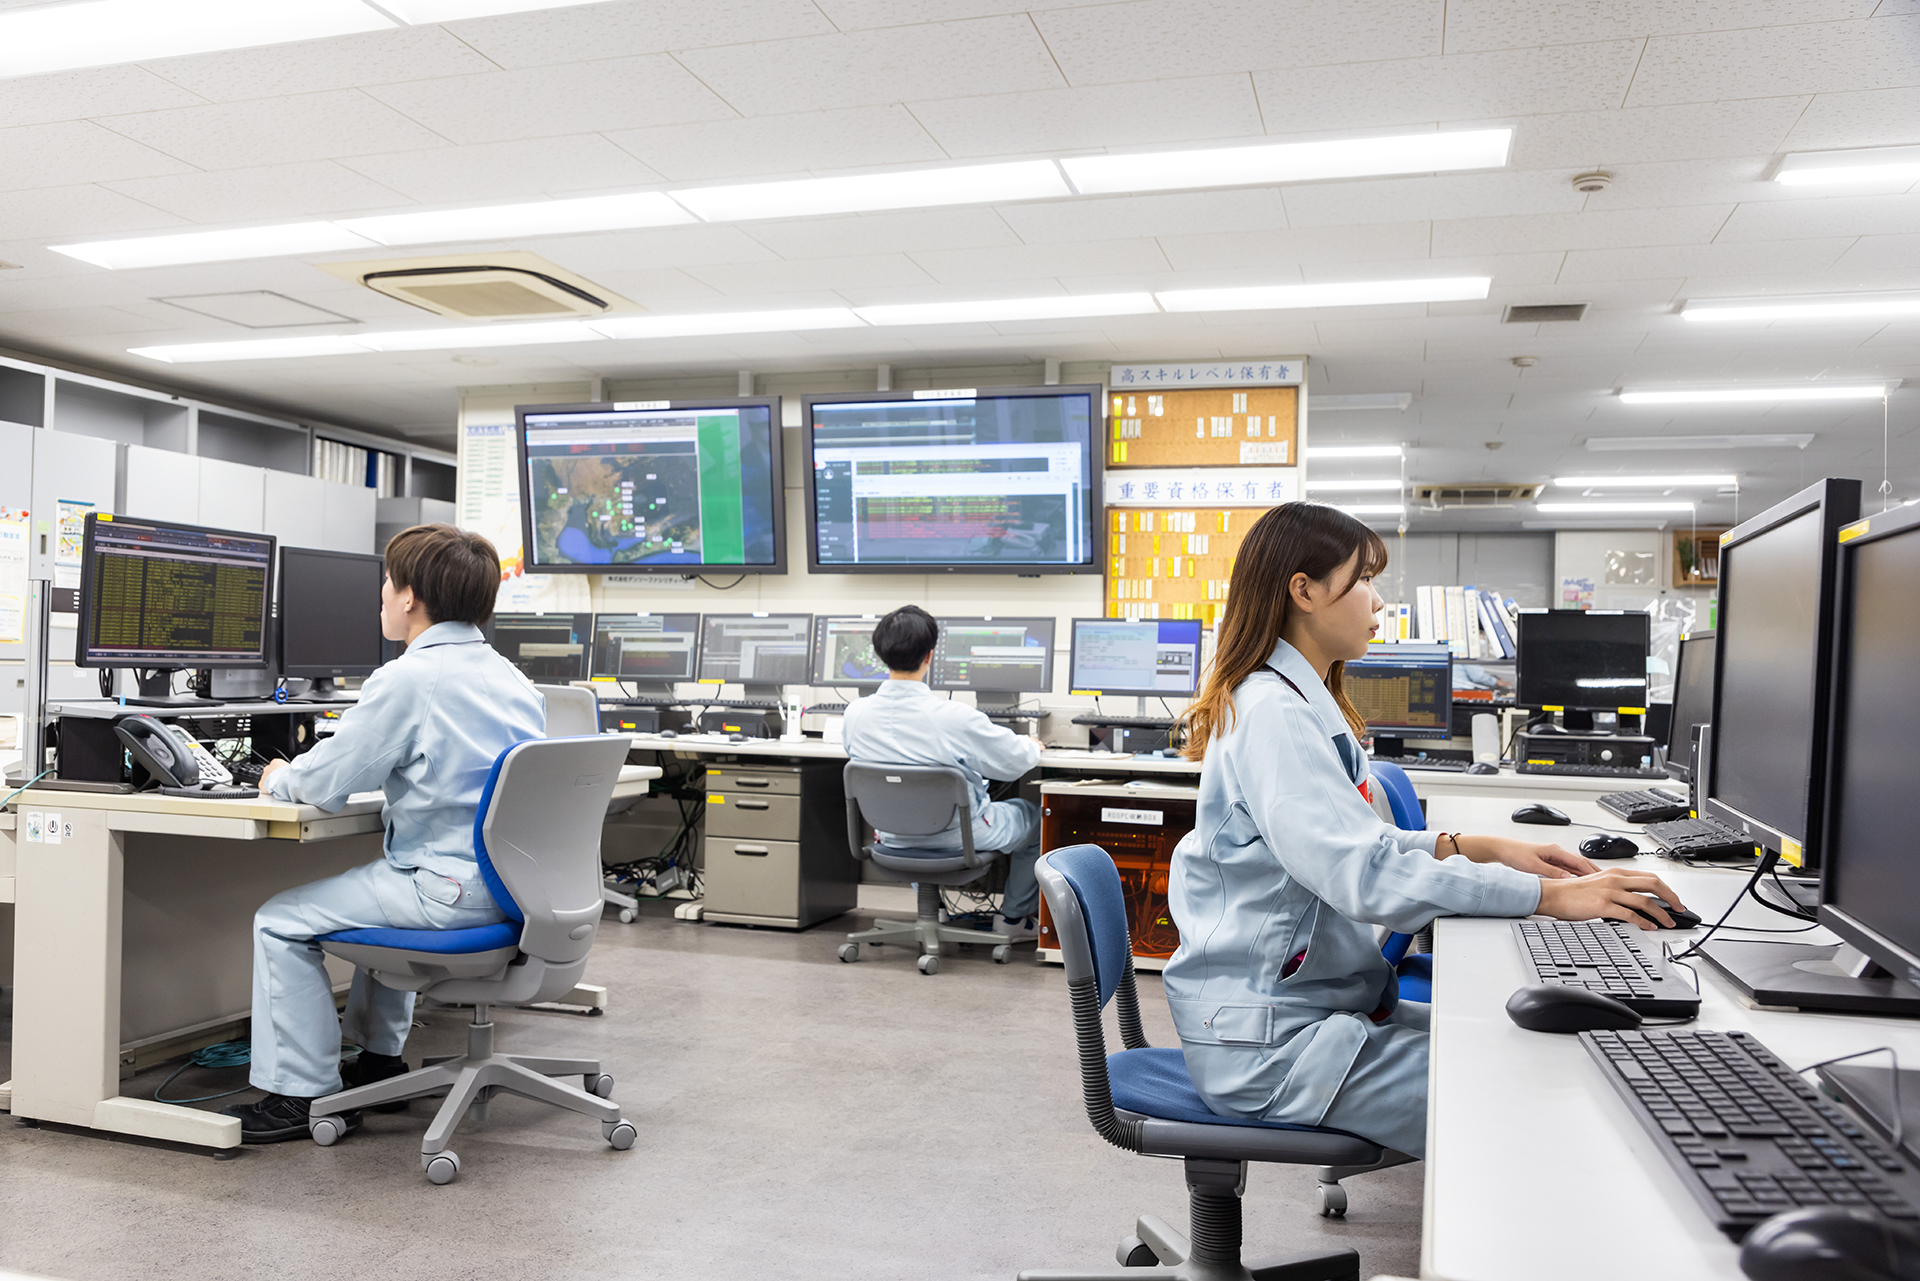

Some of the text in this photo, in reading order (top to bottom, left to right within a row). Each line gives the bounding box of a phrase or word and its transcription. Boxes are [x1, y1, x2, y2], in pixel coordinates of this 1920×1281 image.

[1121, 364, 1290, 383] 高スキルレベル保有者
[1118, 480, 1284, 500] 重要資格保有者
